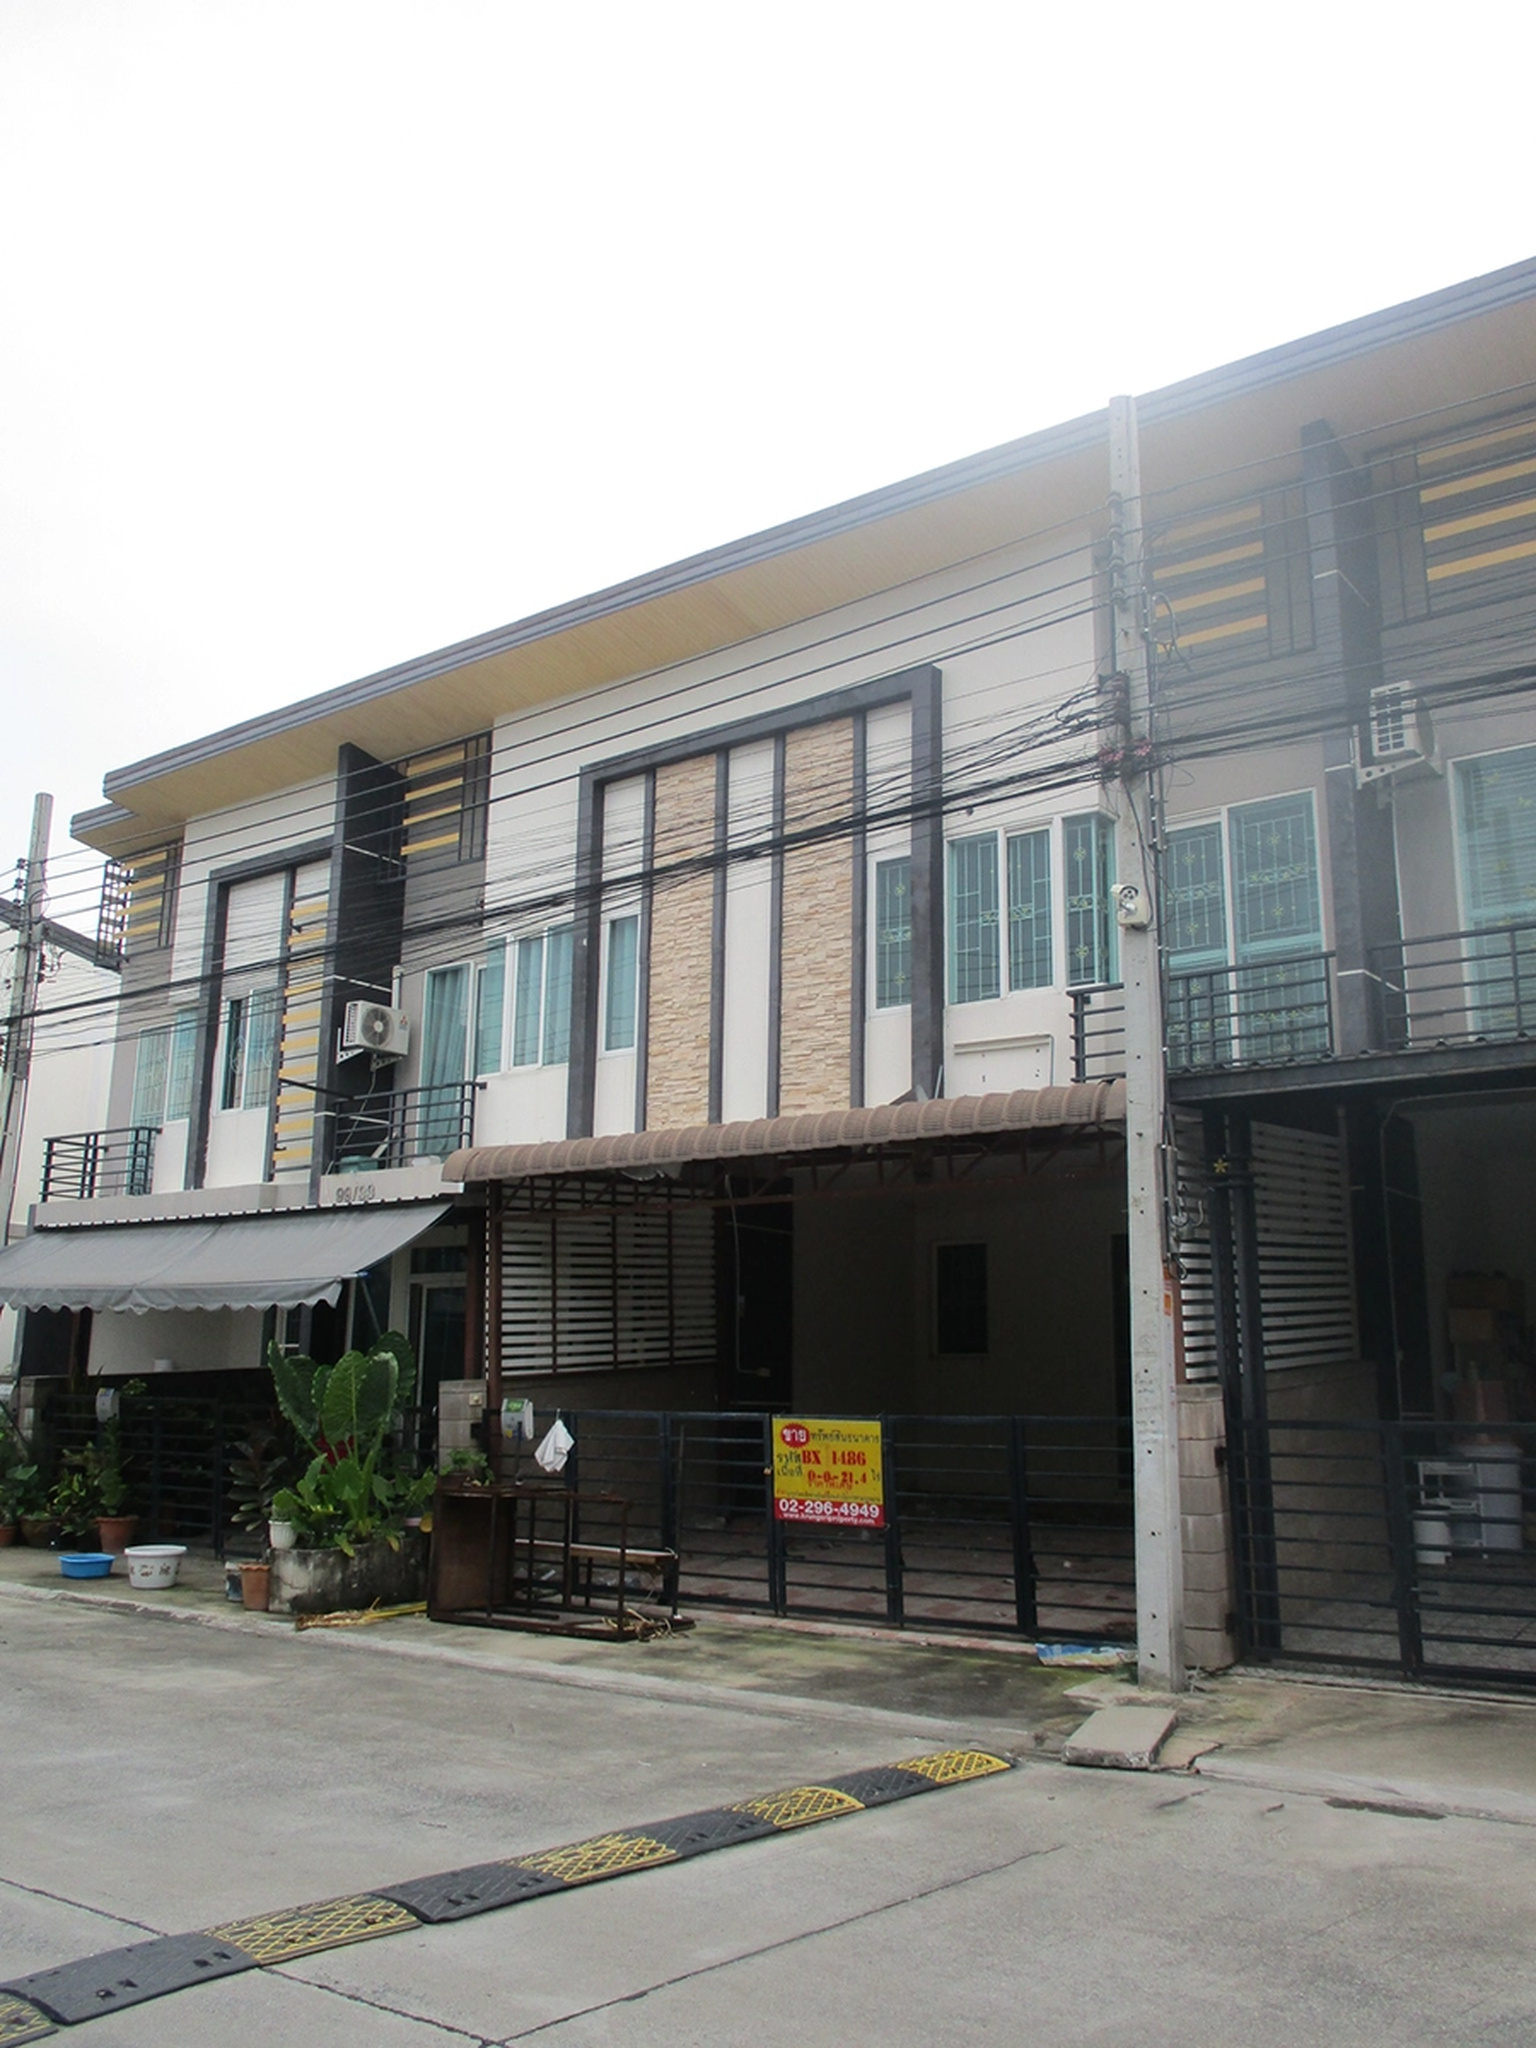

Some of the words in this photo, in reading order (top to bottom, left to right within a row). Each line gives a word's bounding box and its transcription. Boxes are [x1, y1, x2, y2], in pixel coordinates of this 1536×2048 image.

[782, 1428, 807, 1443] ขาย
[802, 1449, 821, 1465] BX
[831, 1450, 867, 1466] 1486
[779, 1498, 880, 1519] 02-296-4949
